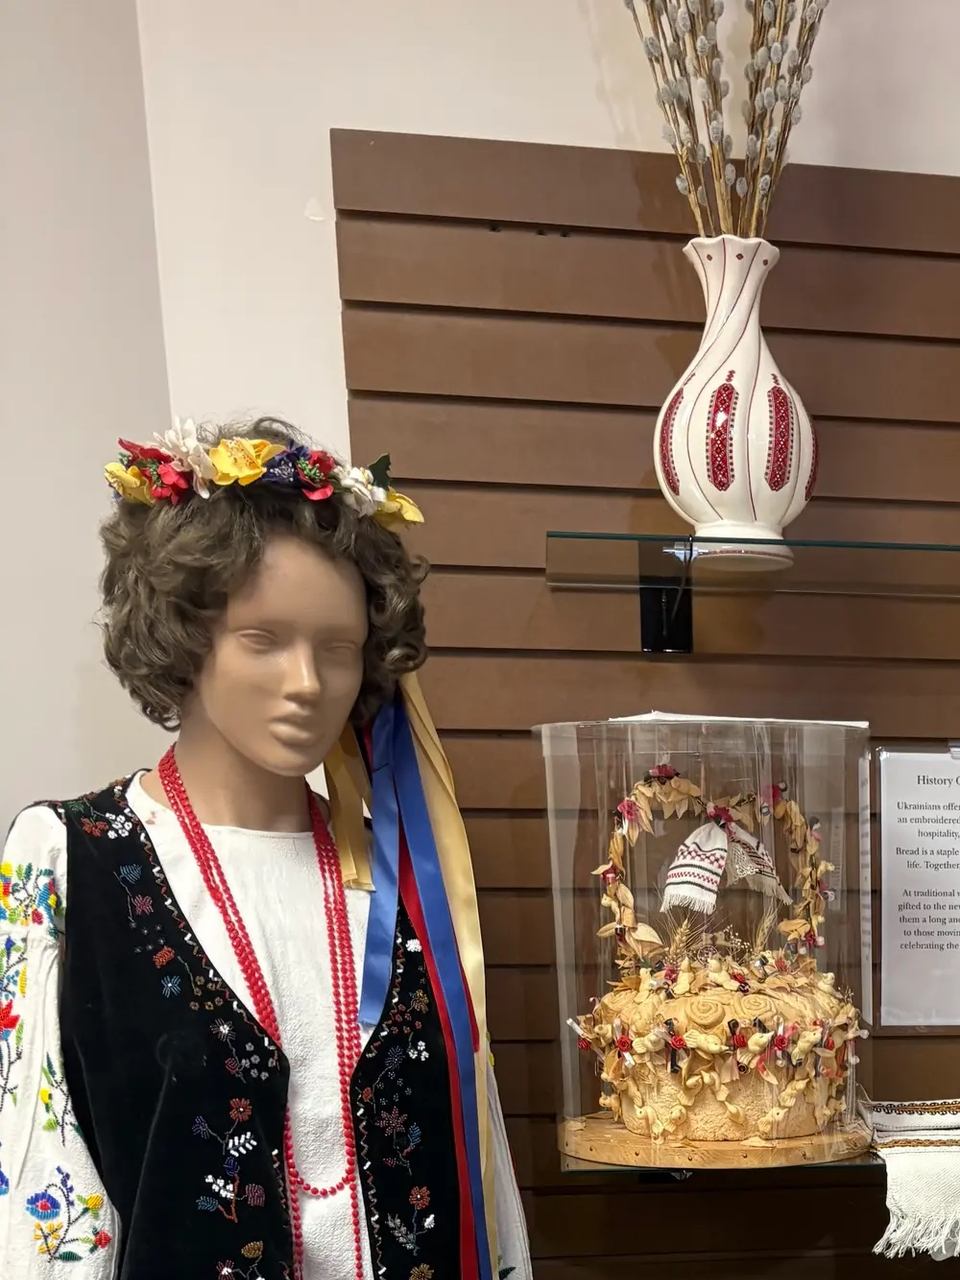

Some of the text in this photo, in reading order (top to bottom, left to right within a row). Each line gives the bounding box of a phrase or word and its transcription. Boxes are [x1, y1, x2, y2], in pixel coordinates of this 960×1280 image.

[917, 775, 954, 788] History
[897, 801, 941, 811] Ukrainians
[918, 829, 960, 841] hospitality,
[896, 847, 920, 856] Bread
[922, 847, 928, 856] is
[936, 848, 960, 859] staple
[907, 860, 922, 872] life.
[902, 889, 912, 898] At
[914, 888, 955, 897] traditional
[898, 901, 922, 913] gifted
[923, 903, 932, 913] to
[933, 902, 947, 911] the
[899, 915, 920, 924] them
[928, 915, 947, 926] long
[914, 928, 935, 937] those
[900, 941, 945, 952] celebrating
[946, 941, 960, 950] the
